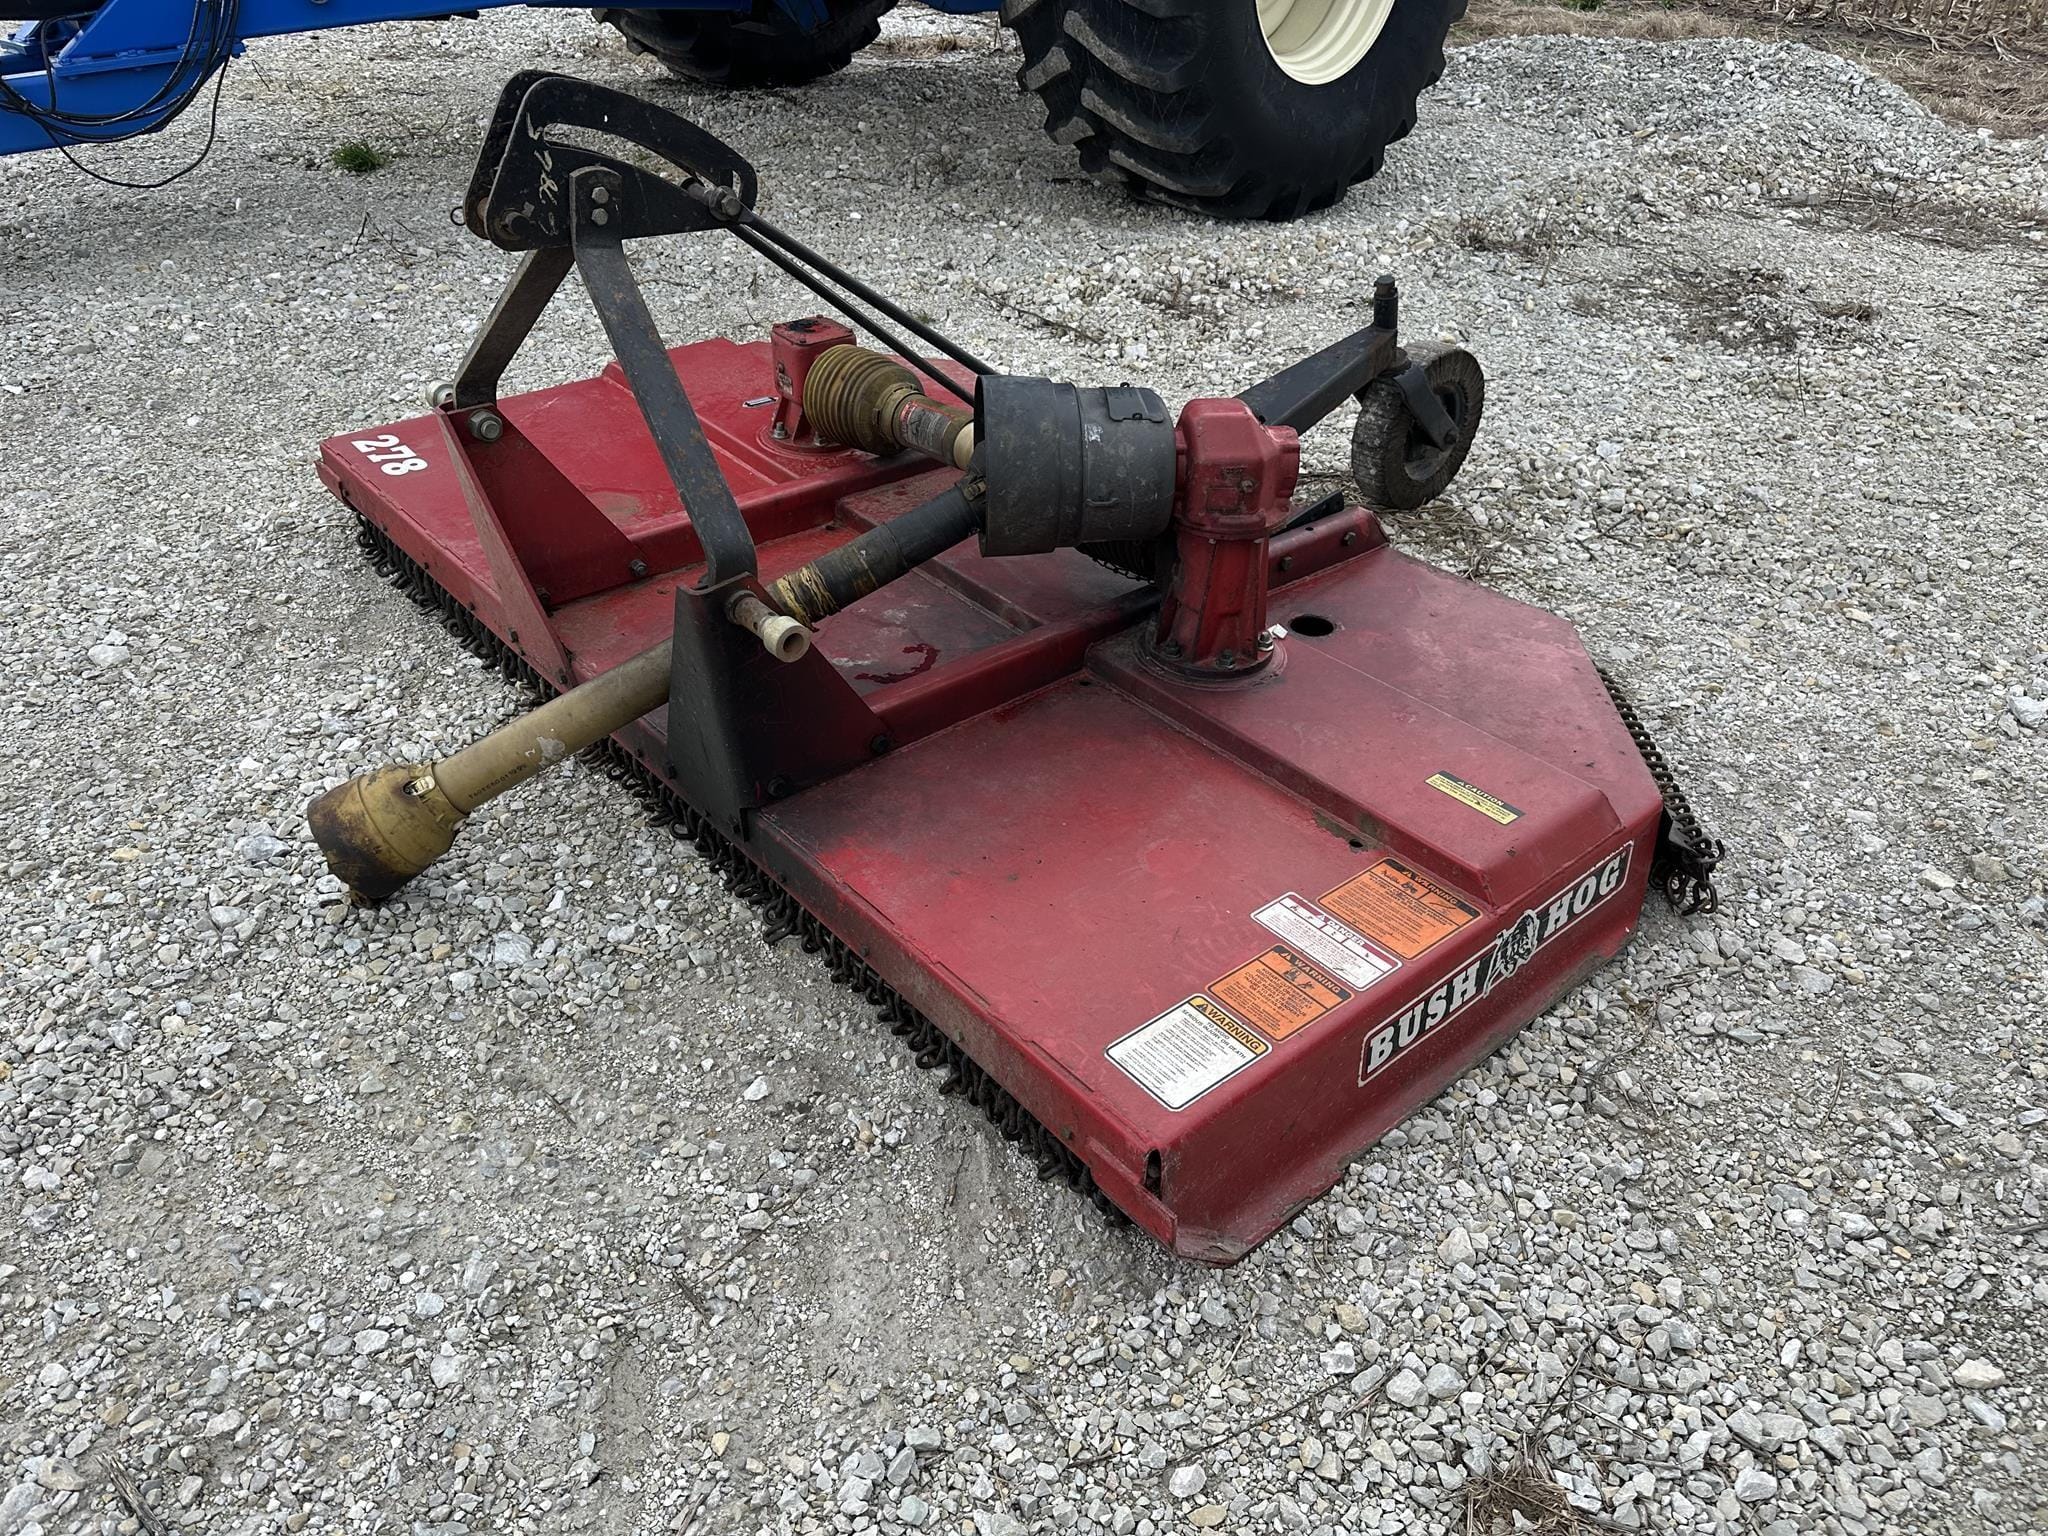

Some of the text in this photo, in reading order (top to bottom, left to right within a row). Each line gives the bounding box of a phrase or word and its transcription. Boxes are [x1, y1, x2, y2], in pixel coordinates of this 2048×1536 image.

[351, 434, 428, 476] 278
[1464, 784, 1505, 806] CAUTION
[1415, 876, 1458, 904] WARNING
[1325, 920, 1366, 946] DANGER
[1292, 959, 1342, 993] WARNING
[1367, 960, 1481, 1074] BUSH
[1544, 858, 1620, 938] HOG
[1180, 1009, 1204, 1026] SERIOUS
[1201, 1024, 1222, 1040] INJURY
[1227, 1044, 1247, 1059] DEATH
[1205, 1008, 1263, 1050] WARNING
[1213, 1027, 1230, 1040] AVOID
